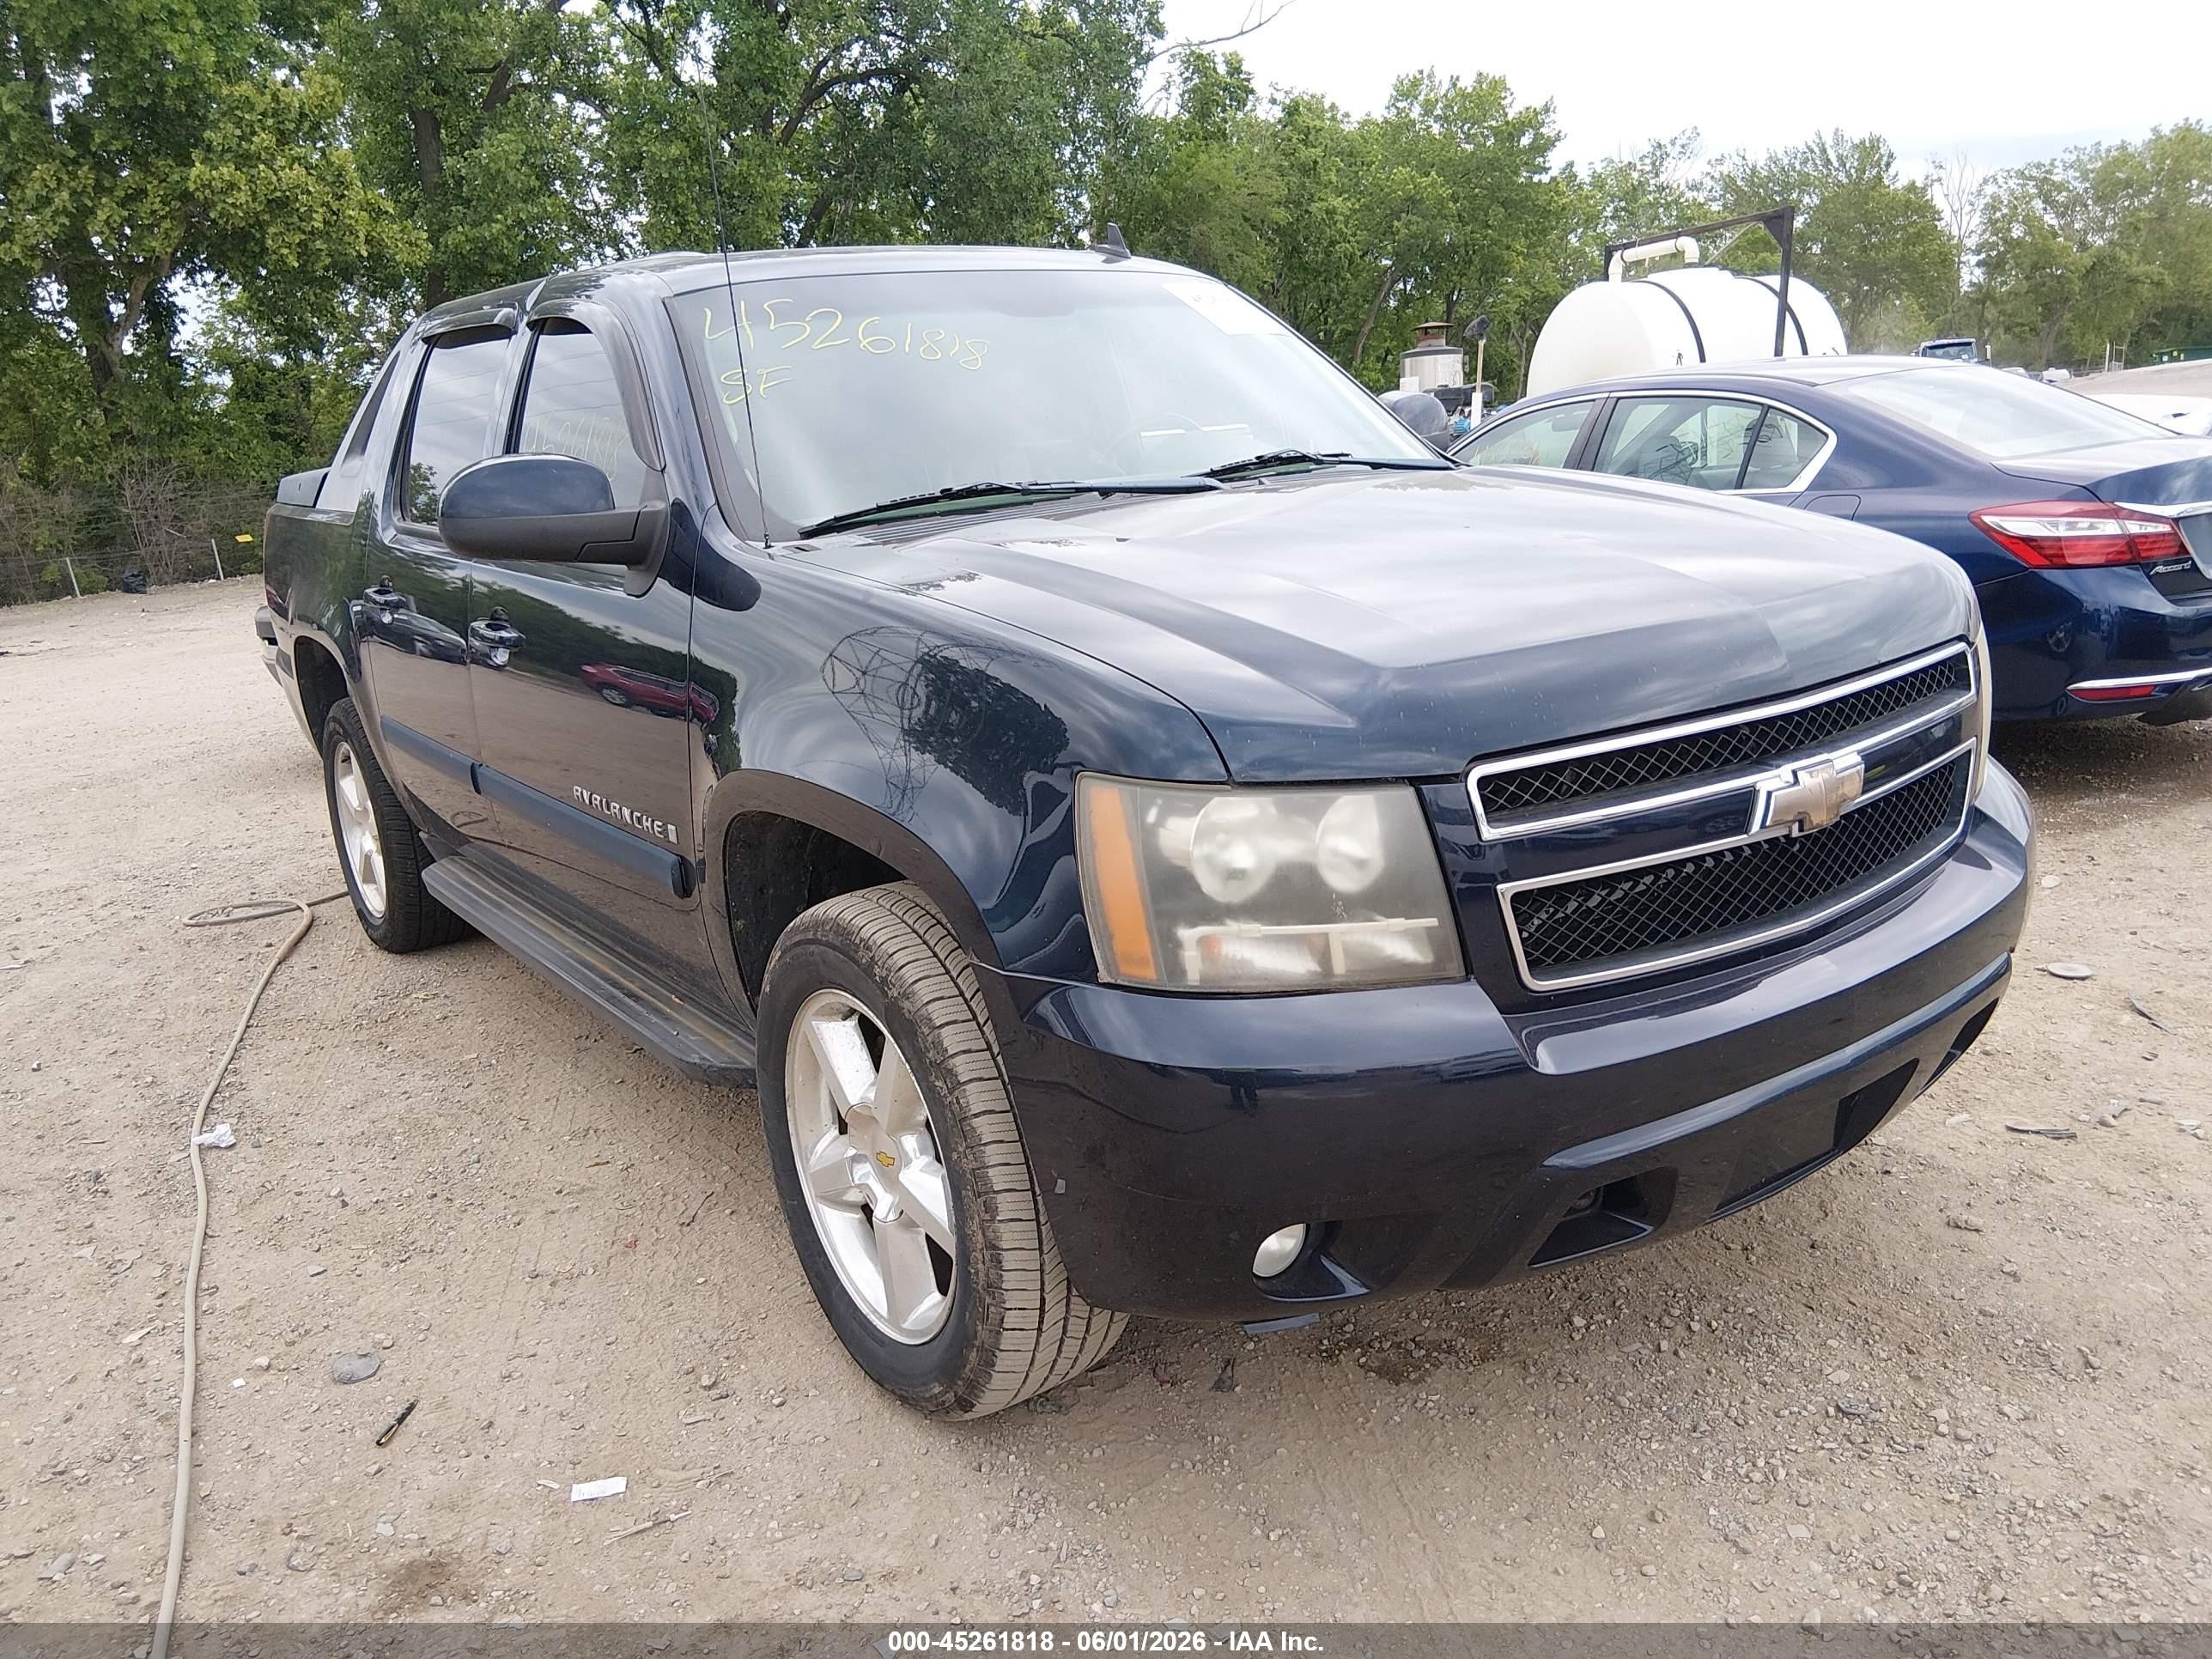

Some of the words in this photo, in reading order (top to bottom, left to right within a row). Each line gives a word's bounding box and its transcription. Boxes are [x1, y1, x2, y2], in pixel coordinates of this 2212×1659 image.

[703, 298, 990, 371] 45261818
[720, 365, 793, 405] SF
[2148, 560, 2192, 576] Accord
[572, 785, 665, 839] AVALANCHE
